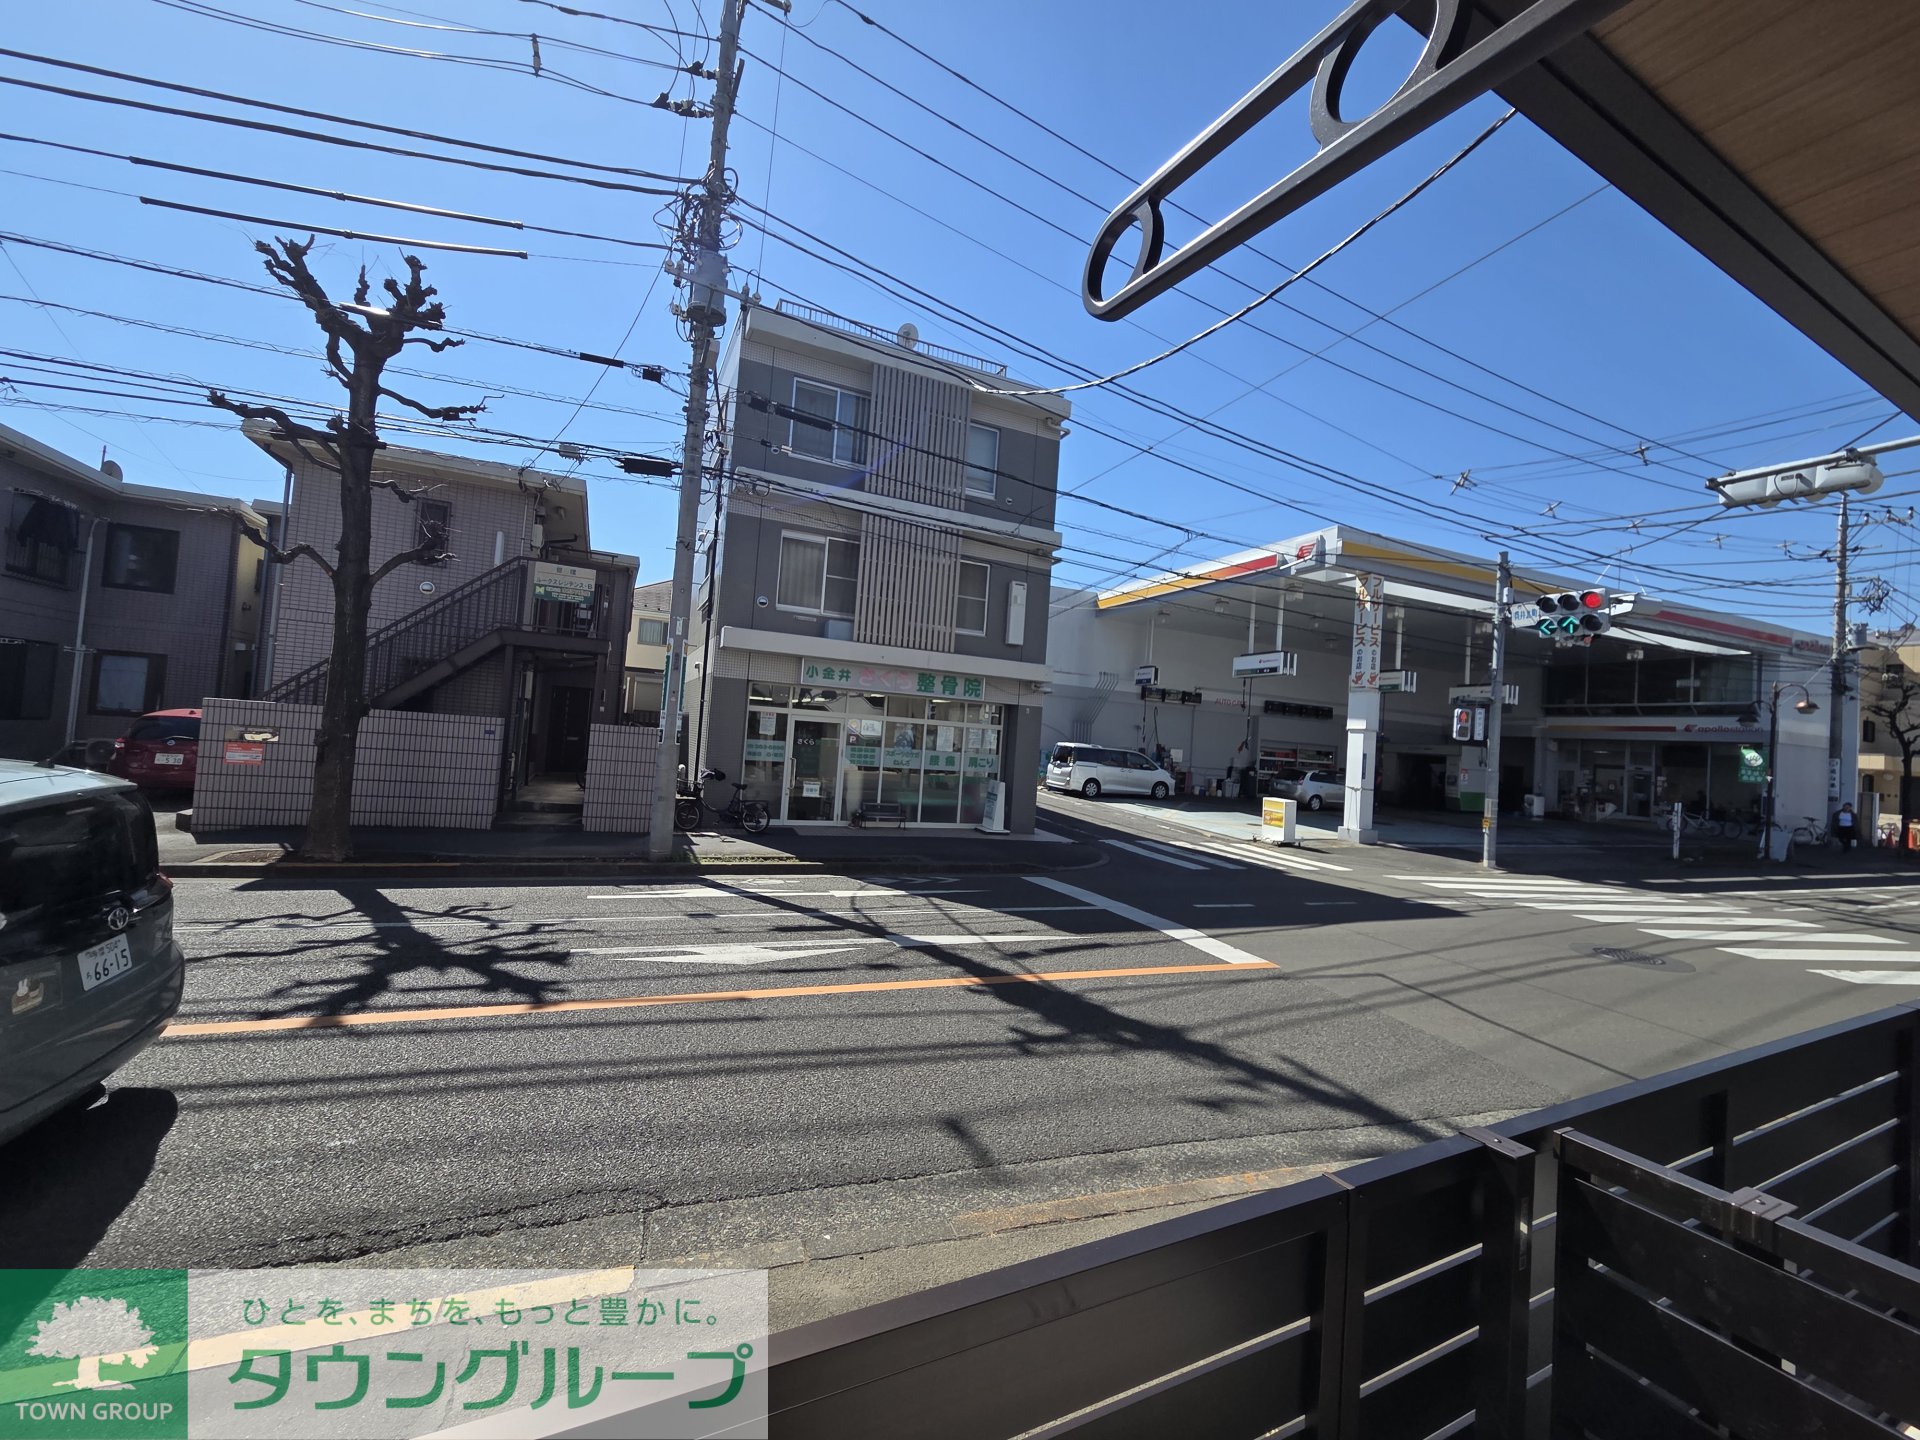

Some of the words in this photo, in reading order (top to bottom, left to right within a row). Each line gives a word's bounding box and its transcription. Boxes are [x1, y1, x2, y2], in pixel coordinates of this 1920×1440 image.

[797, 738, 815, 746] さくら
[968, 756, 994, 768] 肩こり
[94, 948, 129, 981] 66-15
